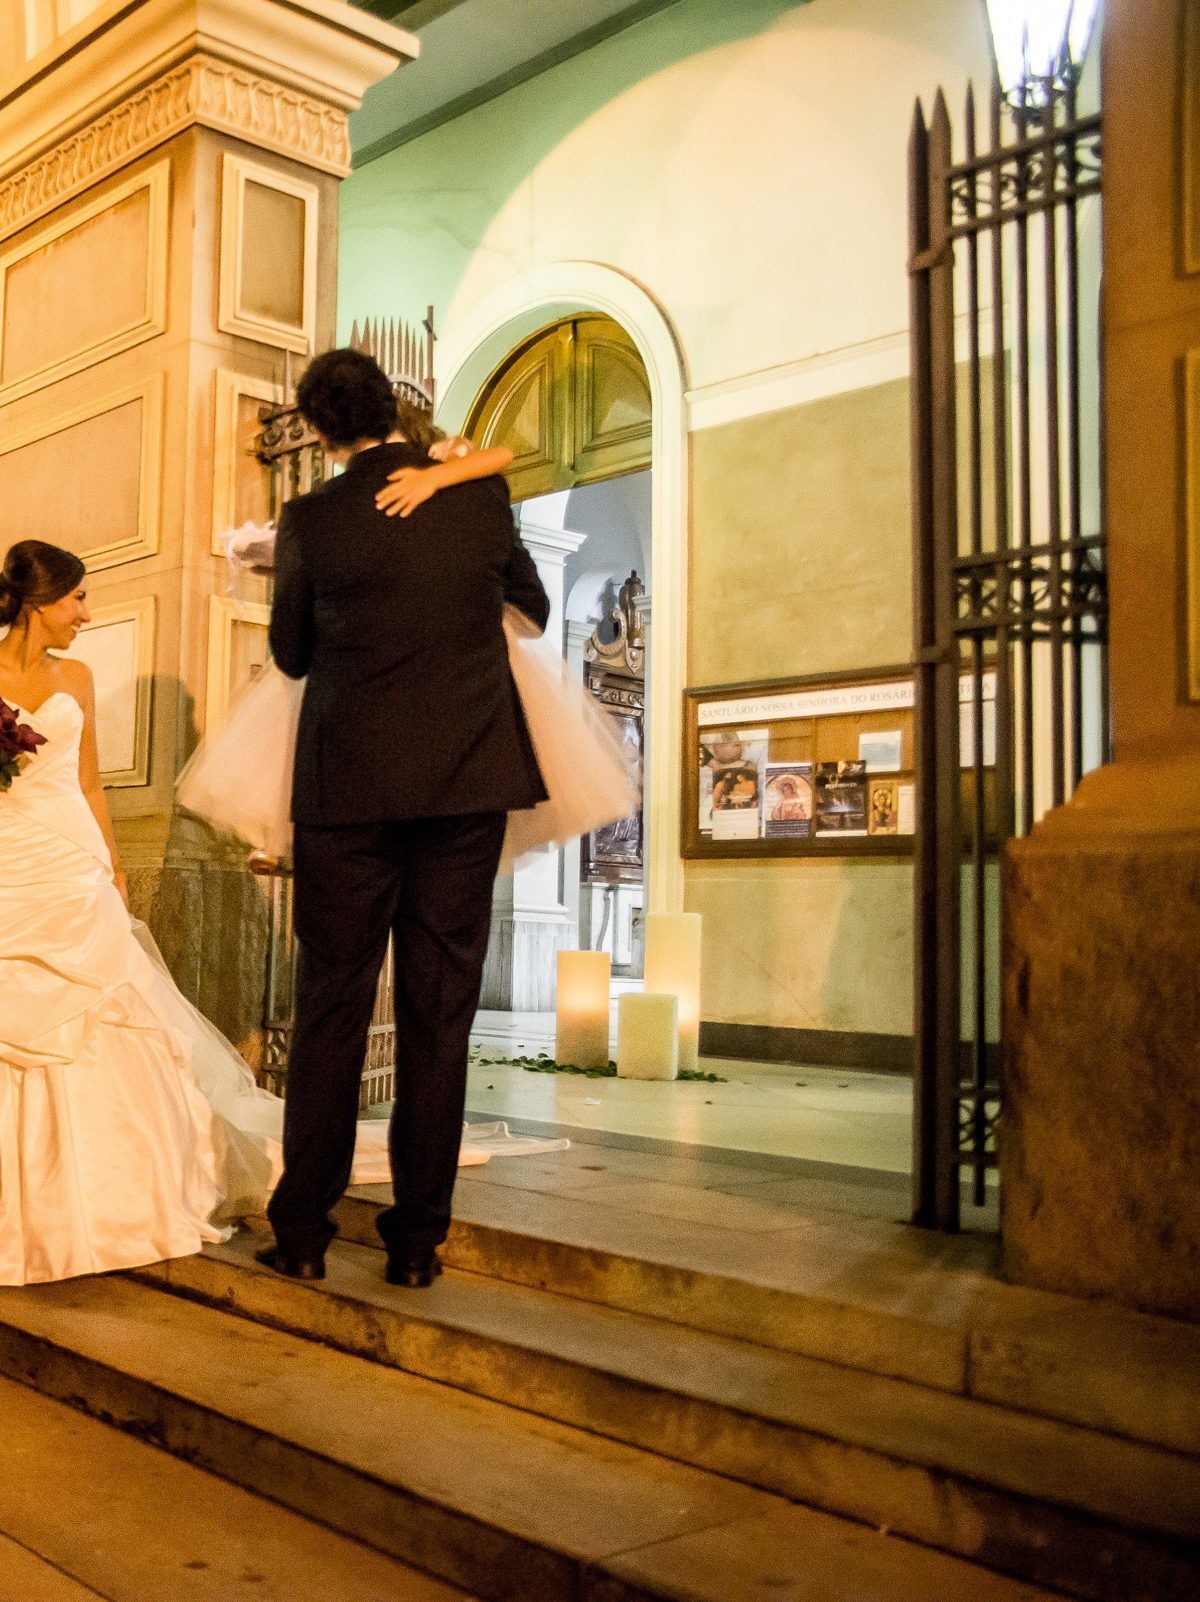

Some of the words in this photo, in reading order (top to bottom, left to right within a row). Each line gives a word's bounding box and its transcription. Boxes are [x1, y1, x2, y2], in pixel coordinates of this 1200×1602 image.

[758, 701, 794, 713] NOSSA
[797, 696, 847, 709] SENHORA
[851, 694, 868, 705] DO
[870, 688, 913, 701] ROSÁRI
